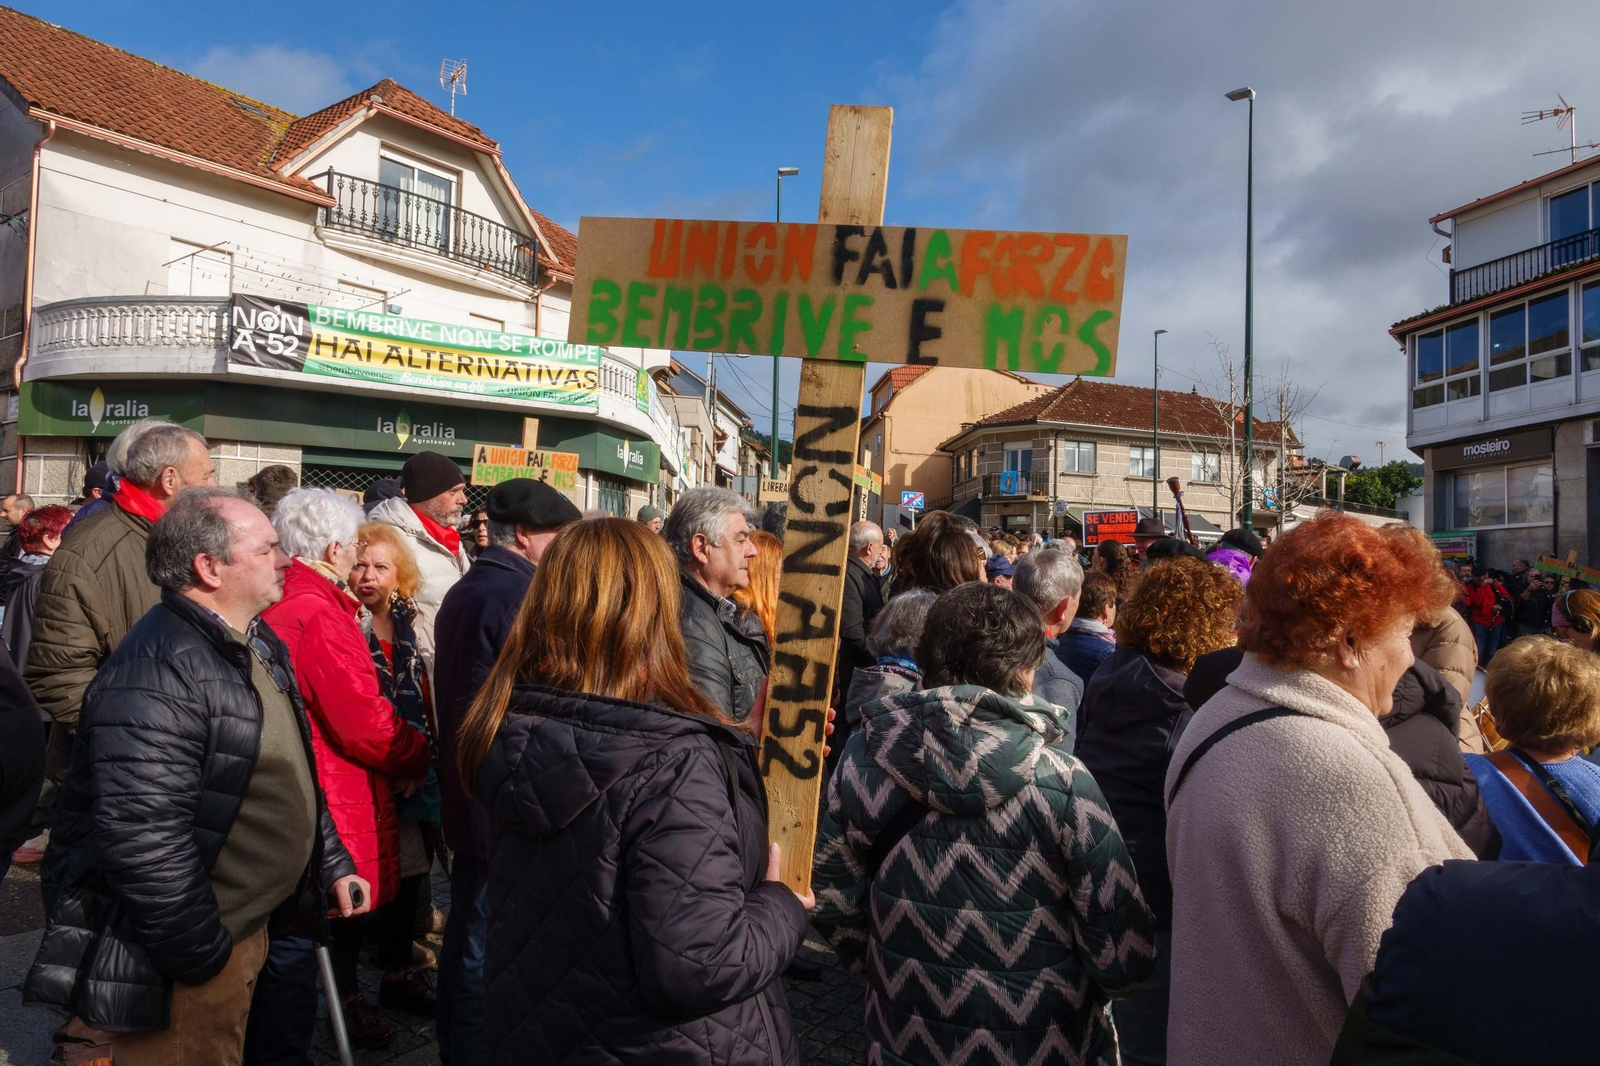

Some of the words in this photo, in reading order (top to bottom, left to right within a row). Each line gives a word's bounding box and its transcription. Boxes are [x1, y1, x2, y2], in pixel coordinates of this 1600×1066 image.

[648, 219, 818, 284] UNION
[832, 225, 916, 289] FAI
[919, 230, 960, 293] A
[960, 230, 1114, 303] FORZA
[232, 305, 304, 336] NON
[315, 305, 433, 341] BEMBRIVE
[440, 325, 493, 349] NON
[499, 335, 523, 353] SE
[529, 337, 598, 363] ROMPE
[586, 279, 875, 361] BEMBRIVE
[907, 299, 946, 366] E
[985, 303, 1113, 376] MOS
[232, 328, 299, 357] A-52
[315, 333, 372, 362] HAI
[383, 343, 599, 391] ALTERNATIVAS
[412, 437, 456, 446] Agrotendas
[616, 444, 644, 465] laralia
[1463, 438, 1511, 456] mosteiro
[475, 464, 536, 483] BEMBRIVE
[477, 446, 487, 463] A
[490, 448, 526, 466] UNION
[527, 451, 544, 467] FAI
[551, 453, 578, 472] FORZA
[762, 481, 790, 493] LIBERA
[784, 404, 860, 577] NON
[1086, 513, 1099, 524] SE
[1101, 512, 1136, 523] VENDE
[776, 591, 837, 644] A
